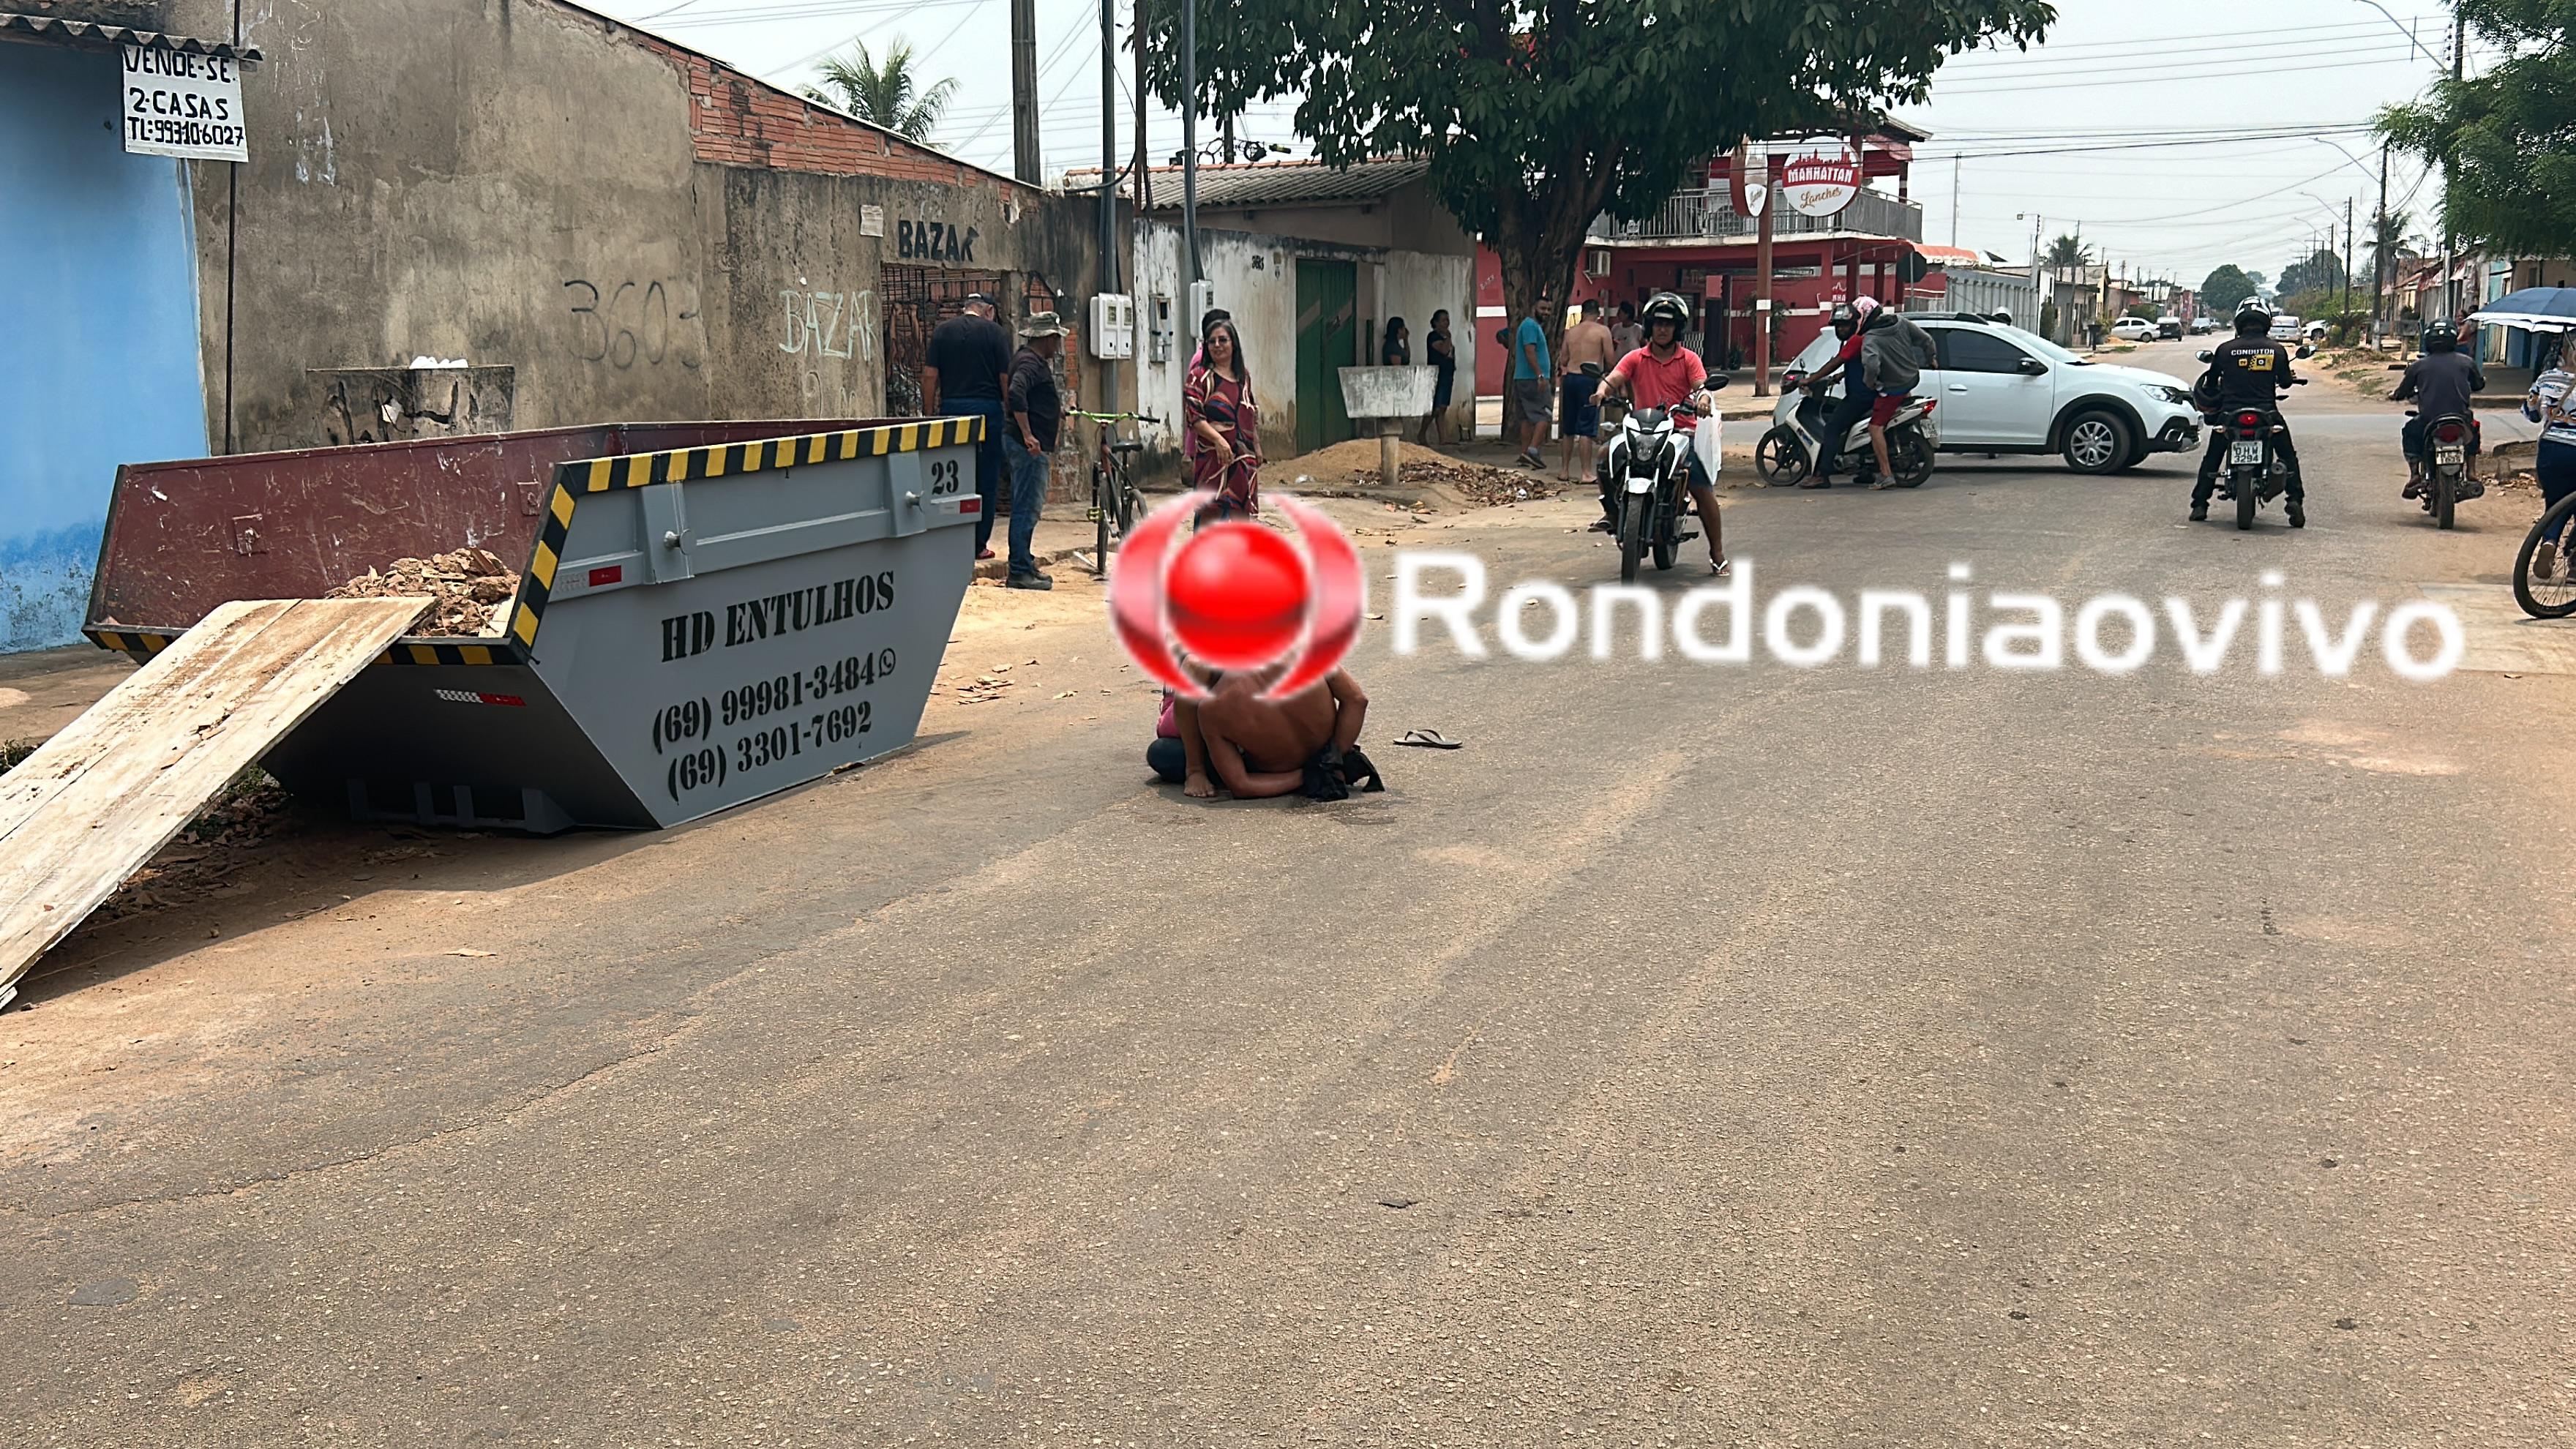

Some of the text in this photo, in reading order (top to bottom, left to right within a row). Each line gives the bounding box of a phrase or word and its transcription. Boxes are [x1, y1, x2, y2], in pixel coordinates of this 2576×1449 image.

[1787, 166, 1854, 184] MANHATTAN
[1800, 187, 1843, 209] Lanches
[898, 220, 980, 263] BAZAR
[778, 289, 877, 362] BAZAR
[2231, 348, 2275, 356] CONDUTOR
[931, 459, 959, 494] 23
[661, 571, 894, 662] HD ENTULHOS
[652, 652, 875, 755] (69) 99981-3484
[668, 700, 872, 803] (69) 3301-7692
